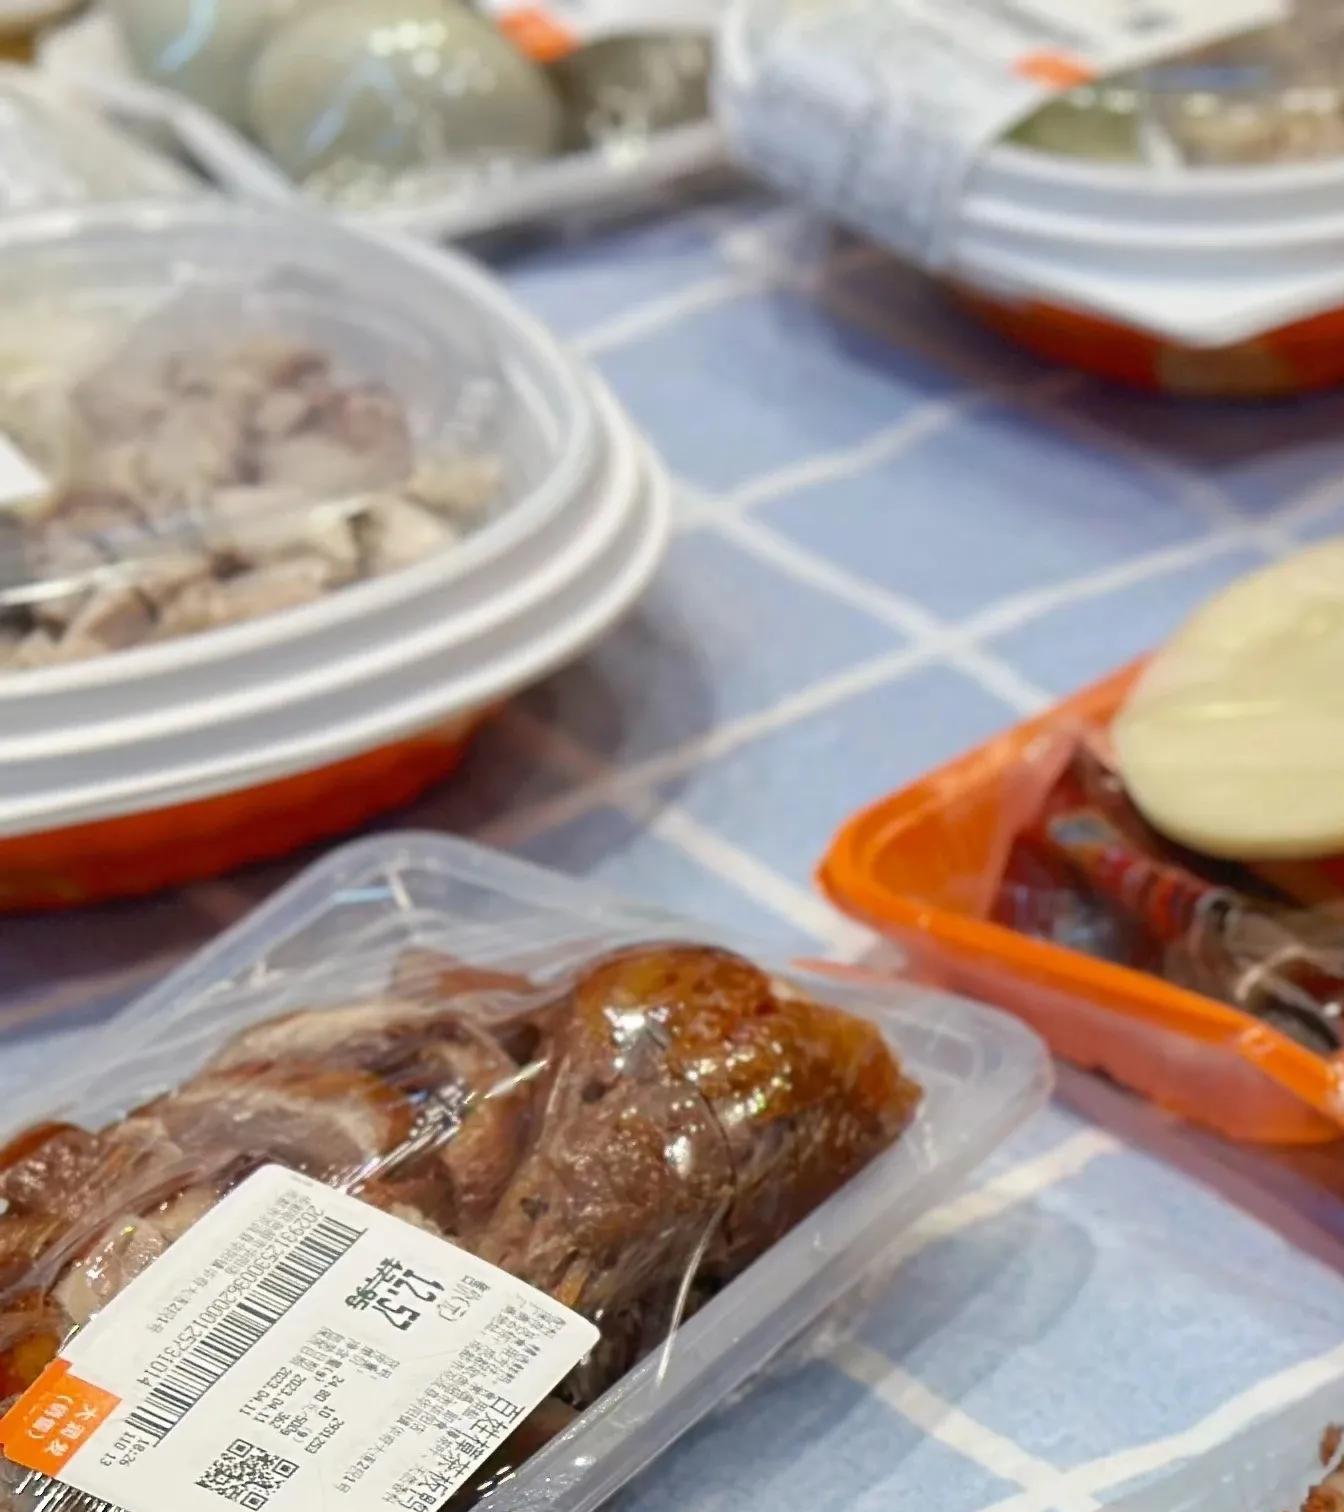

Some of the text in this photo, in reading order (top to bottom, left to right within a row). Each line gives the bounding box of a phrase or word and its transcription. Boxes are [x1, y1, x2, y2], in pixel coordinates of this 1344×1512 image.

[364, 1267, 446, 1331] 12.57
[237, 1365, 293, 1416] 2023.04.11
[251, 1373, 308, 1423] 2023.04.11
[312, 1374, 345, 1403] 24.80
[267, 1410, 291, 1429] 362
[316, 1405, 336, 1419] 10
[302, 1416, 346, 1455] 2931253
